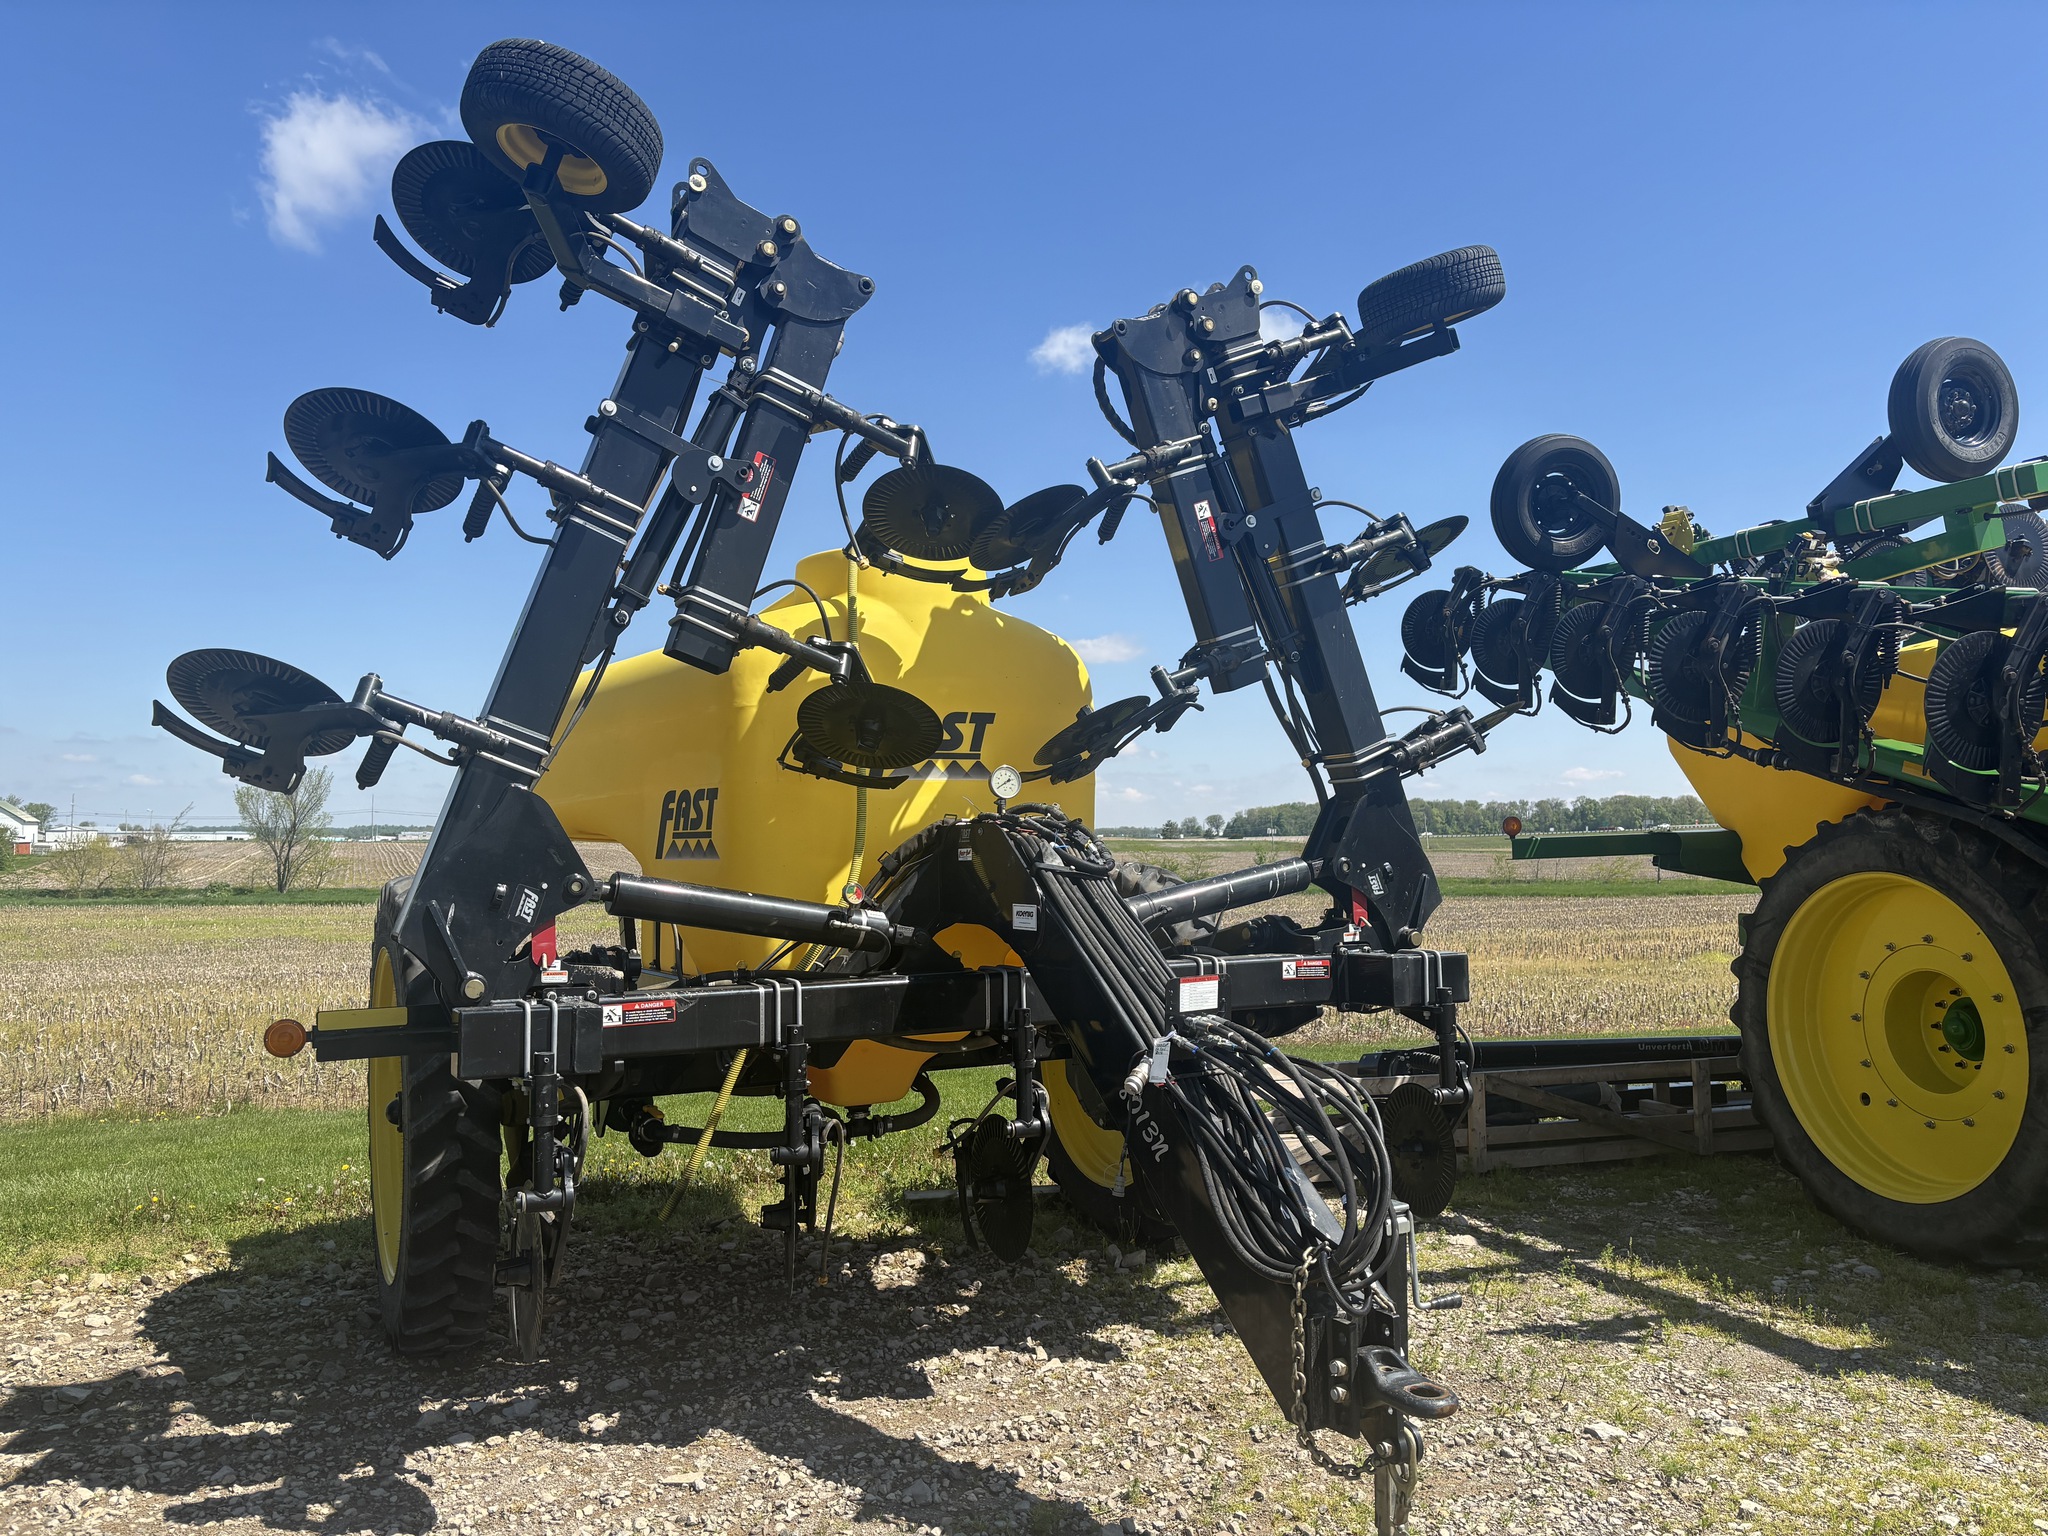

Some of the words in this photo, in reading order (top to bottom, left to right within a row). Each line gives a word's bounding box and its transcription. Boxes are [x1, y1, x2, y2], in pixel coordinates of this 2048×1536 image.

[935, 711, 996, 752] ST
[656, 787, 719, 860] FAST
[1368, 875, 1384, 896] FAST
[520, 888, 539, 923] FAST
